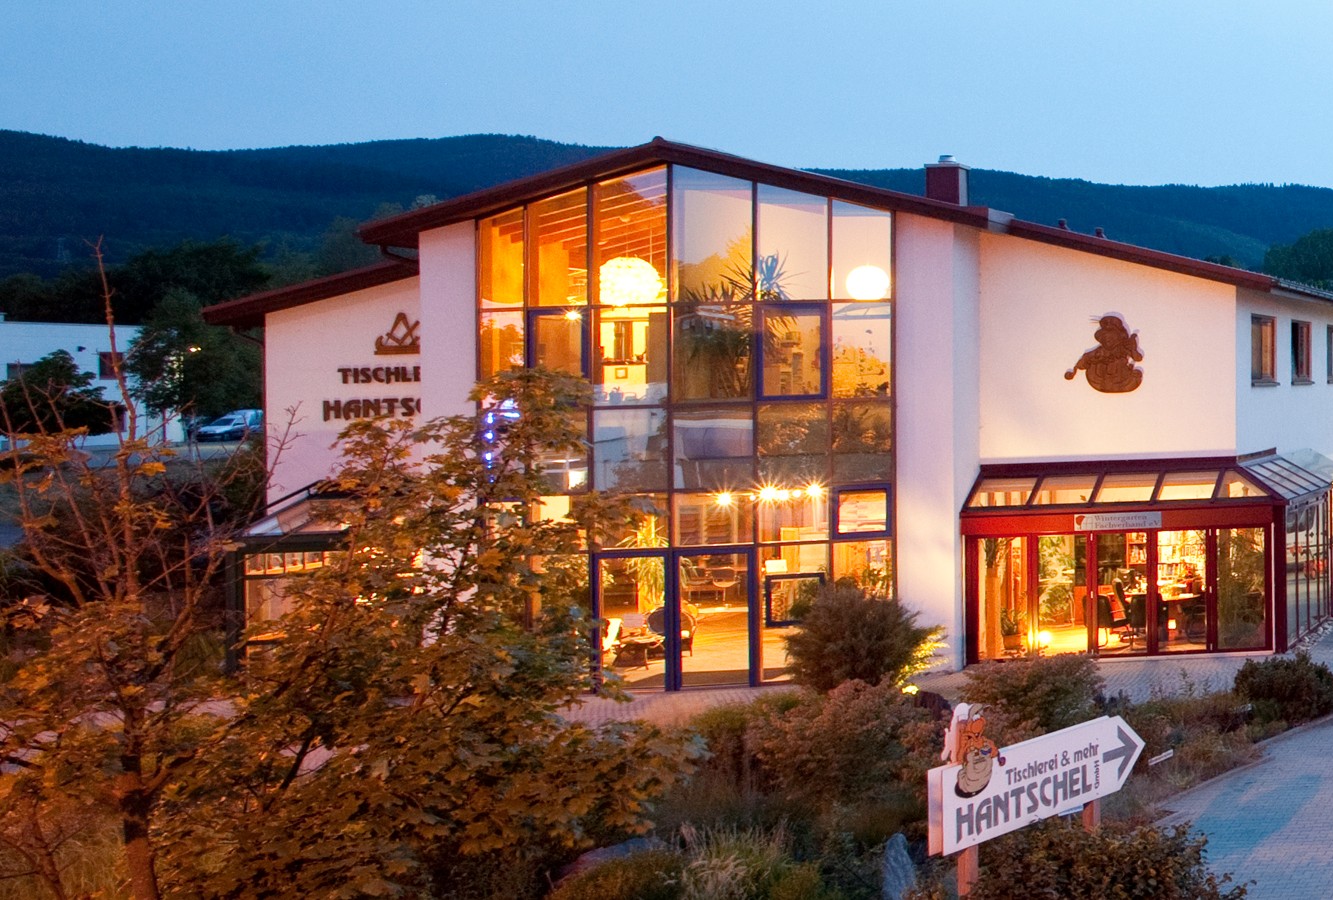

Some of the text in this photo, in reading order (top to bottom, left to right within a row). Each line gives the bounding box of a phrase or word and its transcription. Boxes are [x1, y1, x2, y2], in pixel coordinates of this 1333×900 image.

[1094, 513, 1148, 522] Wintergarten
[1095, 520, 1146, 529] Fachverband
[1005, 742, 1099, 786] Tischlerei & mehr
[956, 764, 1093, 844] HANTSCHEL
